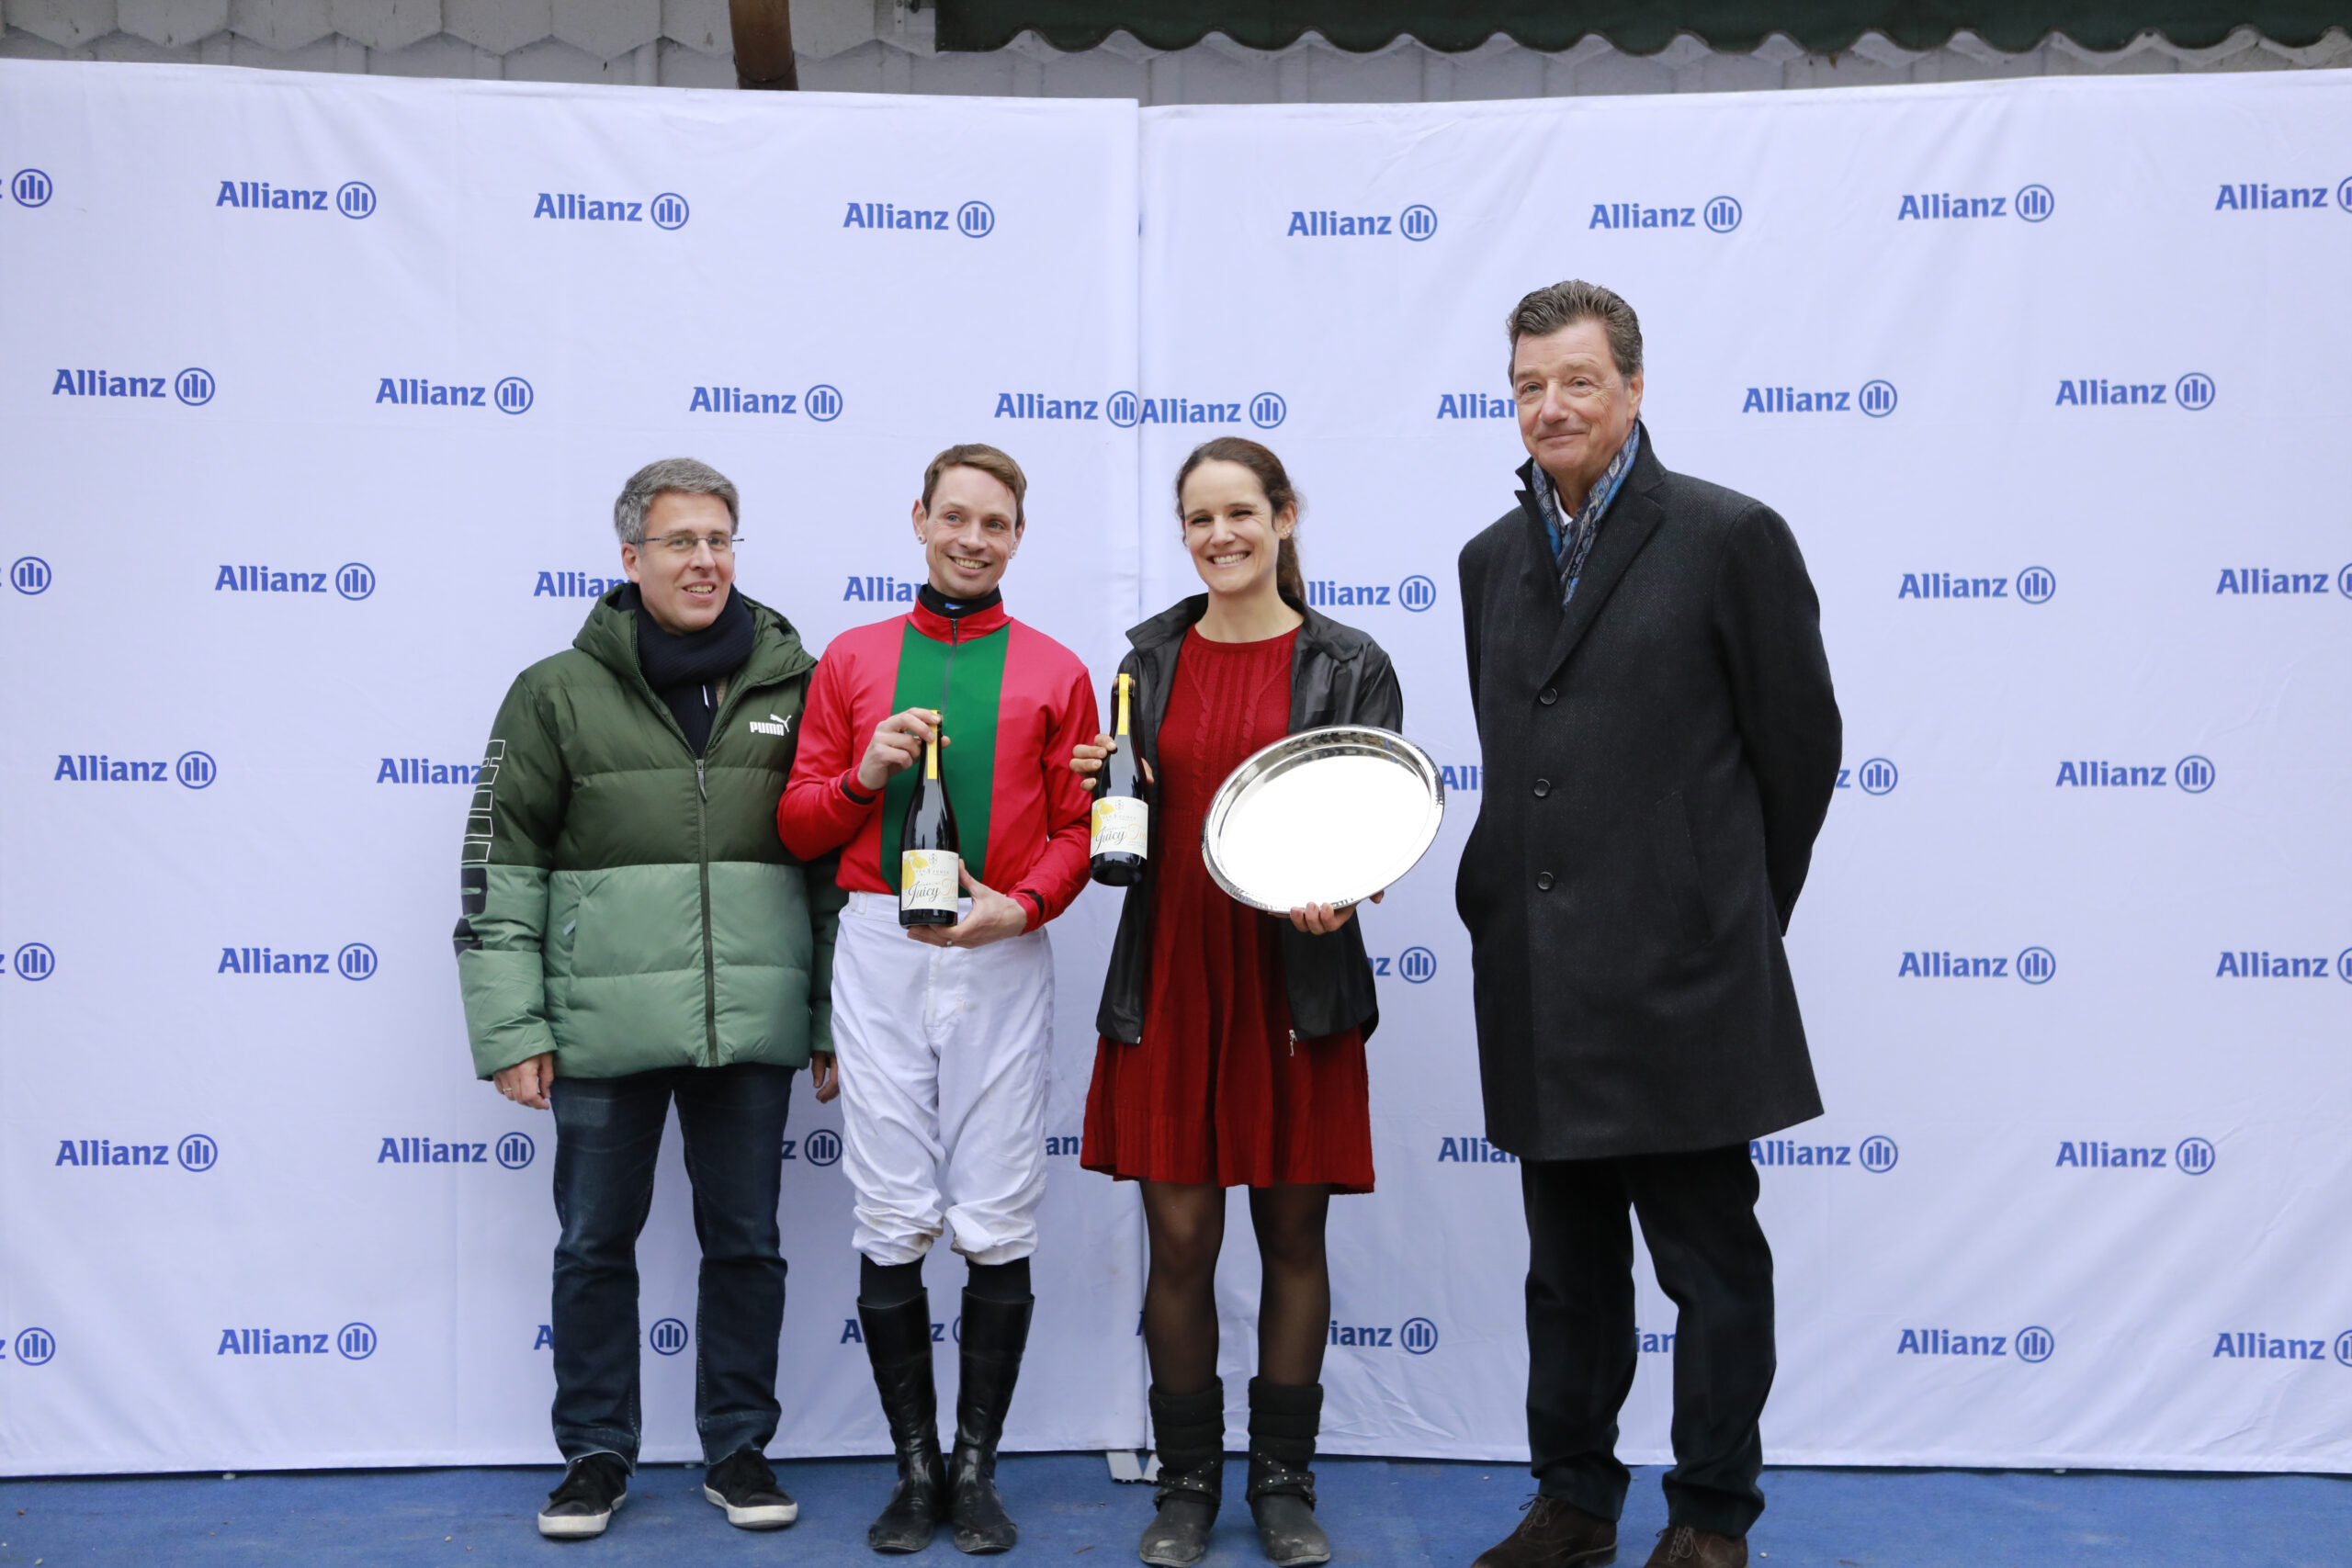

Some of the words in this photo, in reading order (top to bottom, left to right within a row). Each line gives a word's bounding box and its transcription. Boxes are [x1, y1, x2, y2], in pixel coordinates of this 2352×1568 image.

[217, 181, 328, 210] Allianz
[534, 193, 642, 220] Allianz
[1898, 193, 2006, 220] Allianz
[2216, 184, 2327, 209] Allianz
[843, 203, 948, 230] Allianz
[1288, 211, 1391, 236] Allianz
[1589, 203, 1695, 229] Allianz
[52, 369, 165, 397] Allianz
[376, 378, 485, 406] Allianz
[2056, 379, 2165, 405] Allianz
[690, 387, 797, 413] Allianz
[995, 393, 1098, 419] Allianz
[1140, 398, 1241, 423] Allianz
[1437, 393, 1515, 419] Allia
[1743, 388, 1850, 412] Allianz
[215, 566, 326, 592] Allianz
[534, 571, 630, 597] Allia
[843, 577, 922, 602] Allia
[1899, 573, 2007, 598] Allianz
[2217, 569, 2328, 593] Allianz
[1307, 581, 1390, 605] llianz
[749, 721, 785, 737] PUMA
[54, 755, 167, 781] Allianz
[377, 759, 481, 784] Allianz
[2056, 761, 2166, 786] Allianz
[1092, 826, 1125, 855] Juicy
[904, 880, 941, 908] Juicy
[218, 948, 329, 973] Allianz
[1898, 952, 2007, 976] Allianz
[2216, 952, 2328, 977] Allianz
[55, 1140, 169, 1166] Allianz
[378, 1137, 487, 1163] Allianz
[1438, 1136, 1516, 1163] Allia
[1749, 1140, 1850, 1166] Allianz
[2056, 1142, 2165, 1167] Allianz
[218, 1328, 329, 1355] Allianz
[1329, 1319, 1393, 1347] ianz
[1897, 1329, 2007, 1356] Allianz
[2213, 1333, 2325, 1359] Allianz
